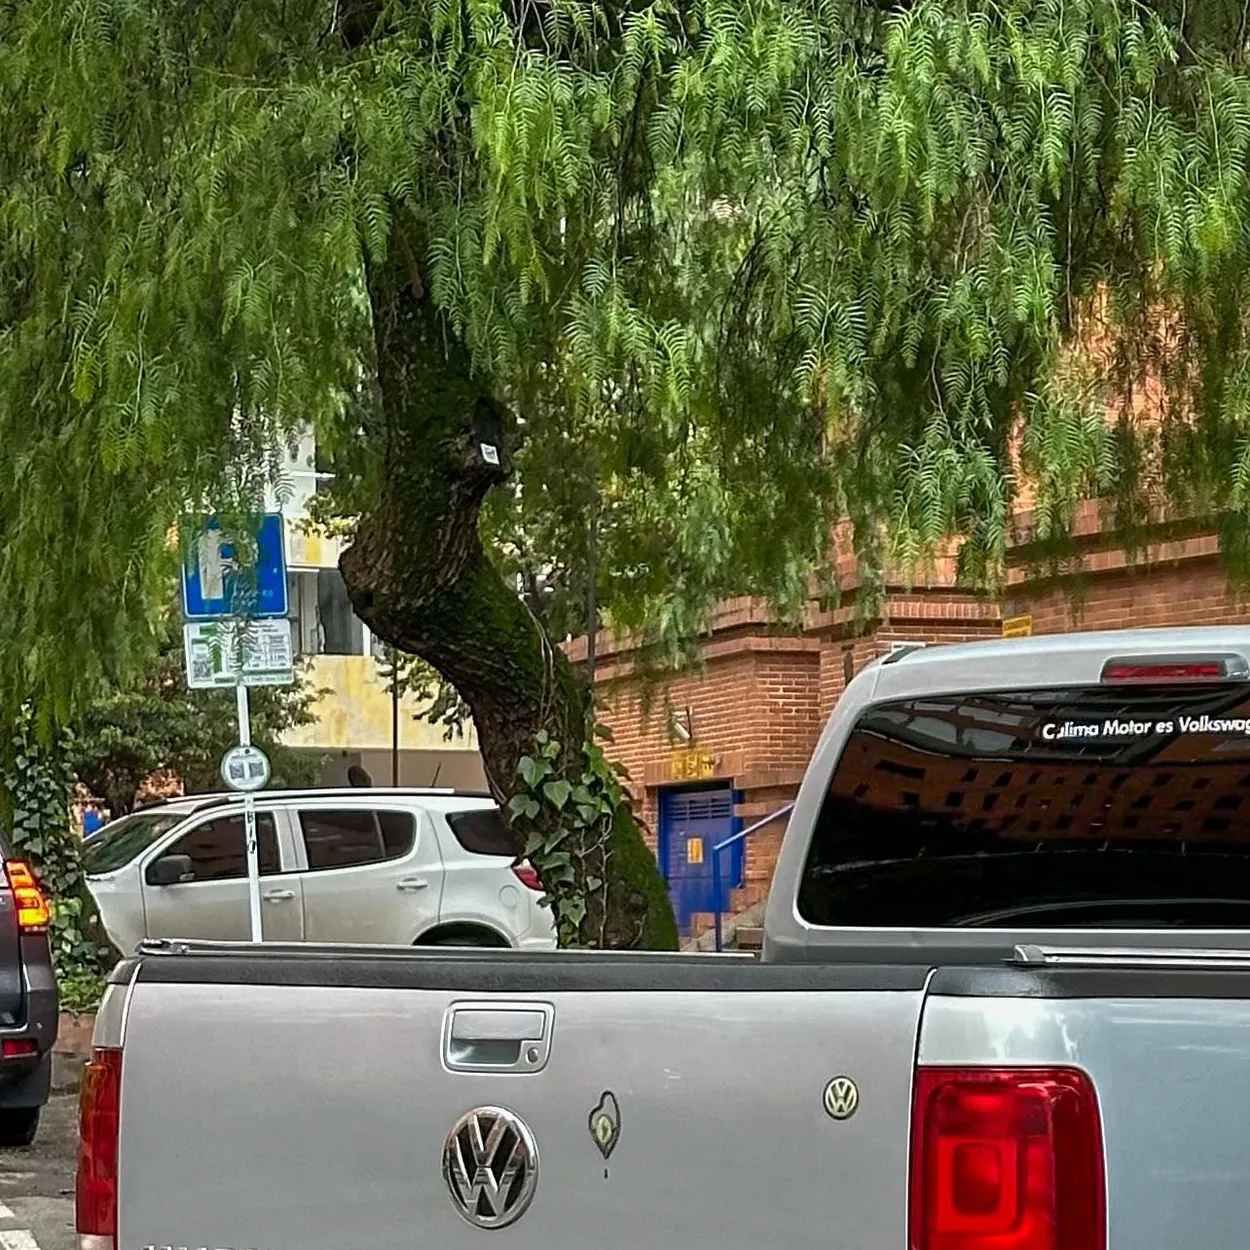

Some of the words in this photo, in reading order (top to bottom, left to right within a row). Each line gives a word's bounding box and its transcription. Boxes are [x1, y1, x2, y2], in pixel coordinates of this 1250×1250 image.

[1103, 719, 1152, 735] Motor
[1155, 720, 1174, 733] es
[826, 1079, 857, 1117] VW
[446, 1110, 536, 1224] VW
